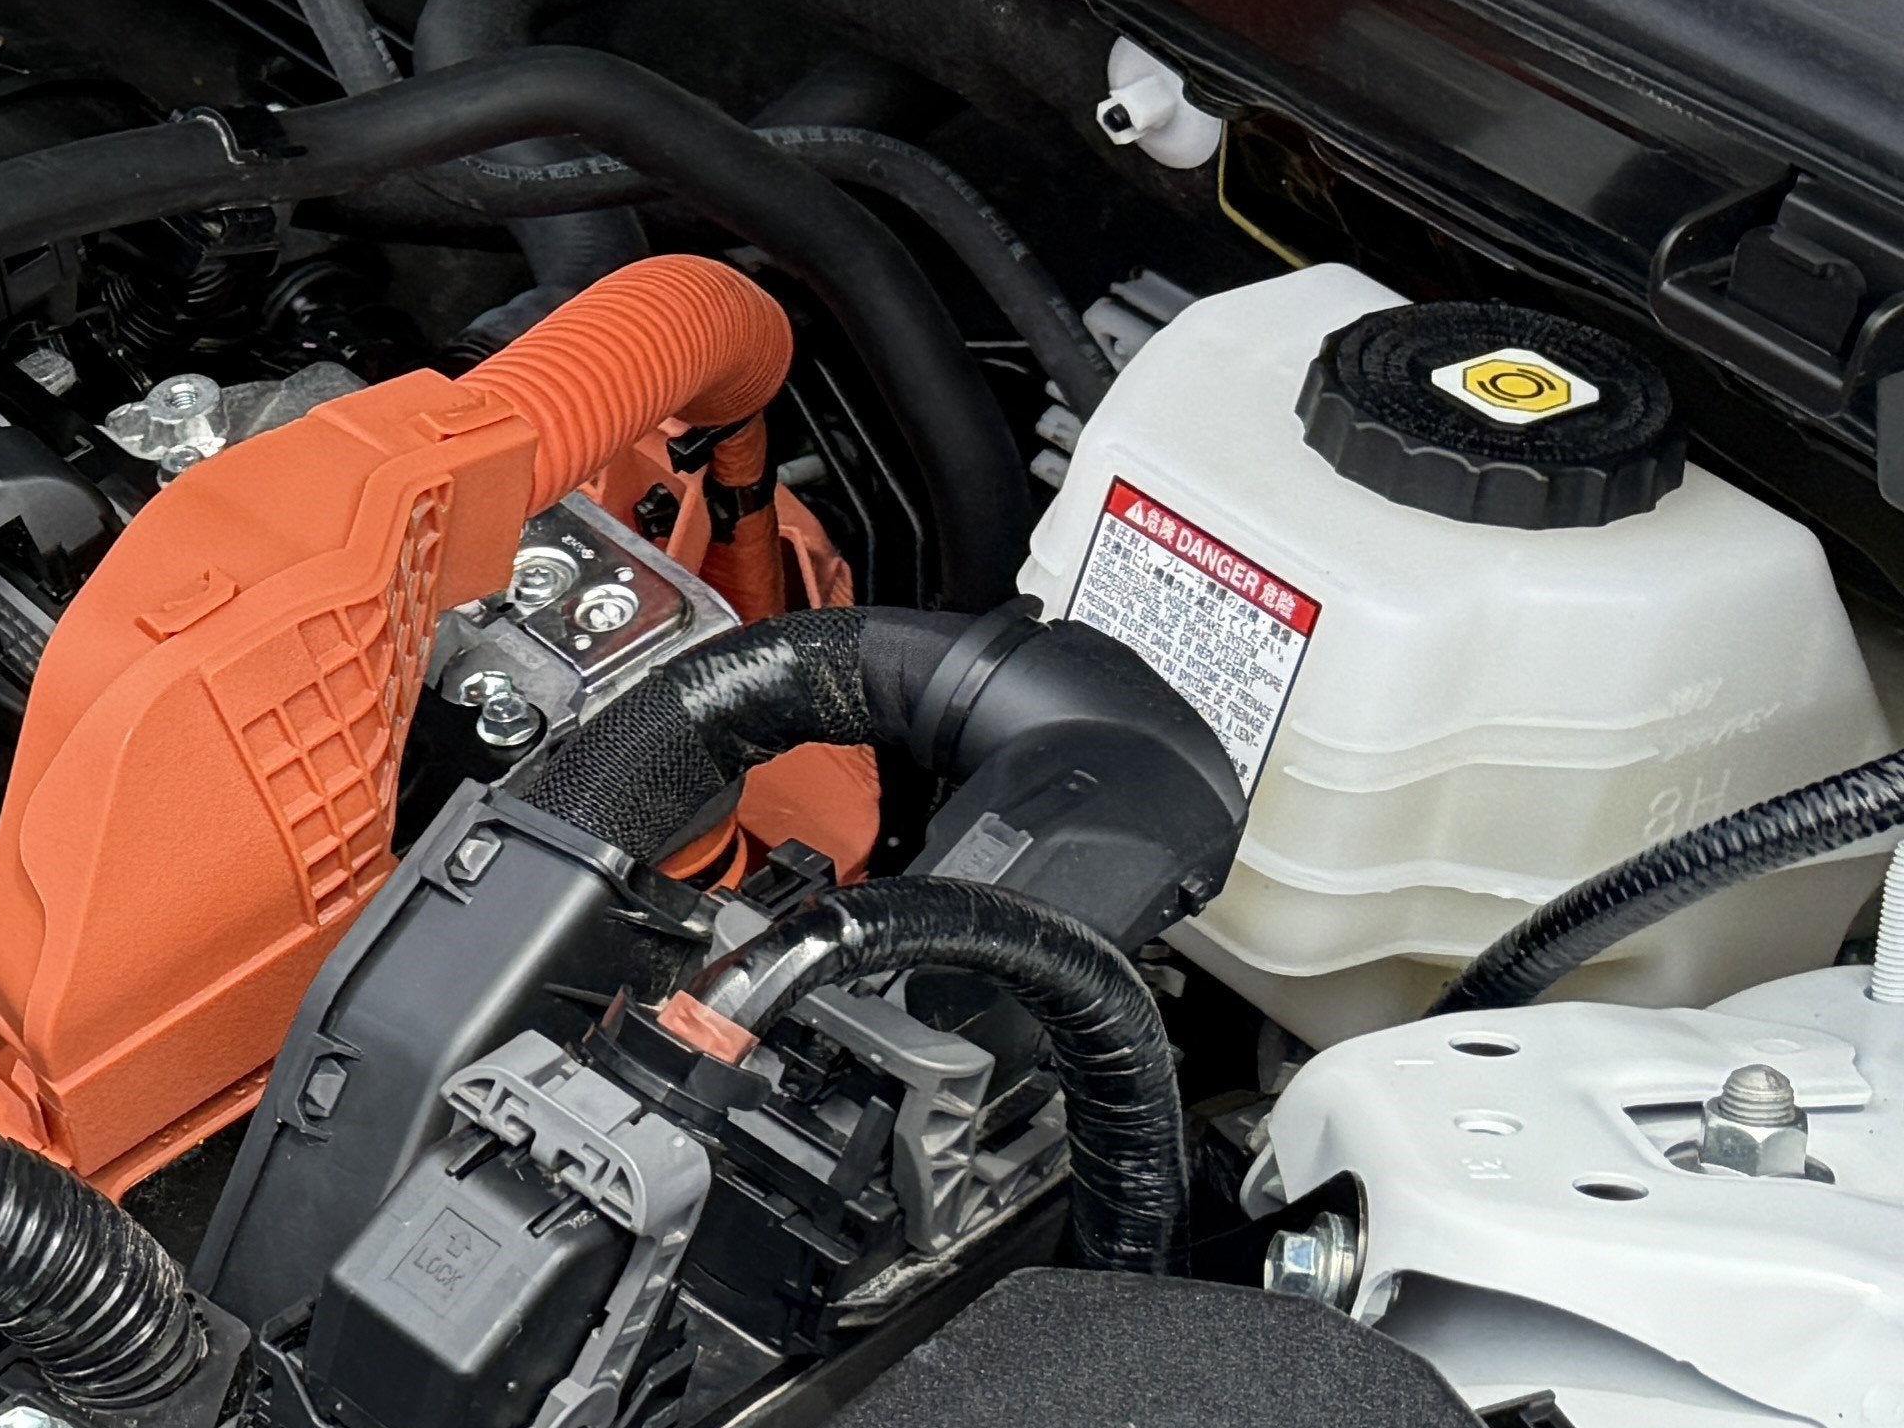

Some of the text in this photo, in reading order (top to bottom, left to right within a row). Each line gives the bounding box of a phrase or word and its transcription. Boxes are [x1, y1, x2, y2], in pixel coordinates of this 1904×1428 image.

[1174, 529, 1263, 598] DANGER
[1213, 639, 1249, 669] SYSTEM
[1249, 662, 1285, 692] BEFORE
[1224, 630, 1259, 660] SYSTEM
[413, 1247, 463, 1291] LOCK
